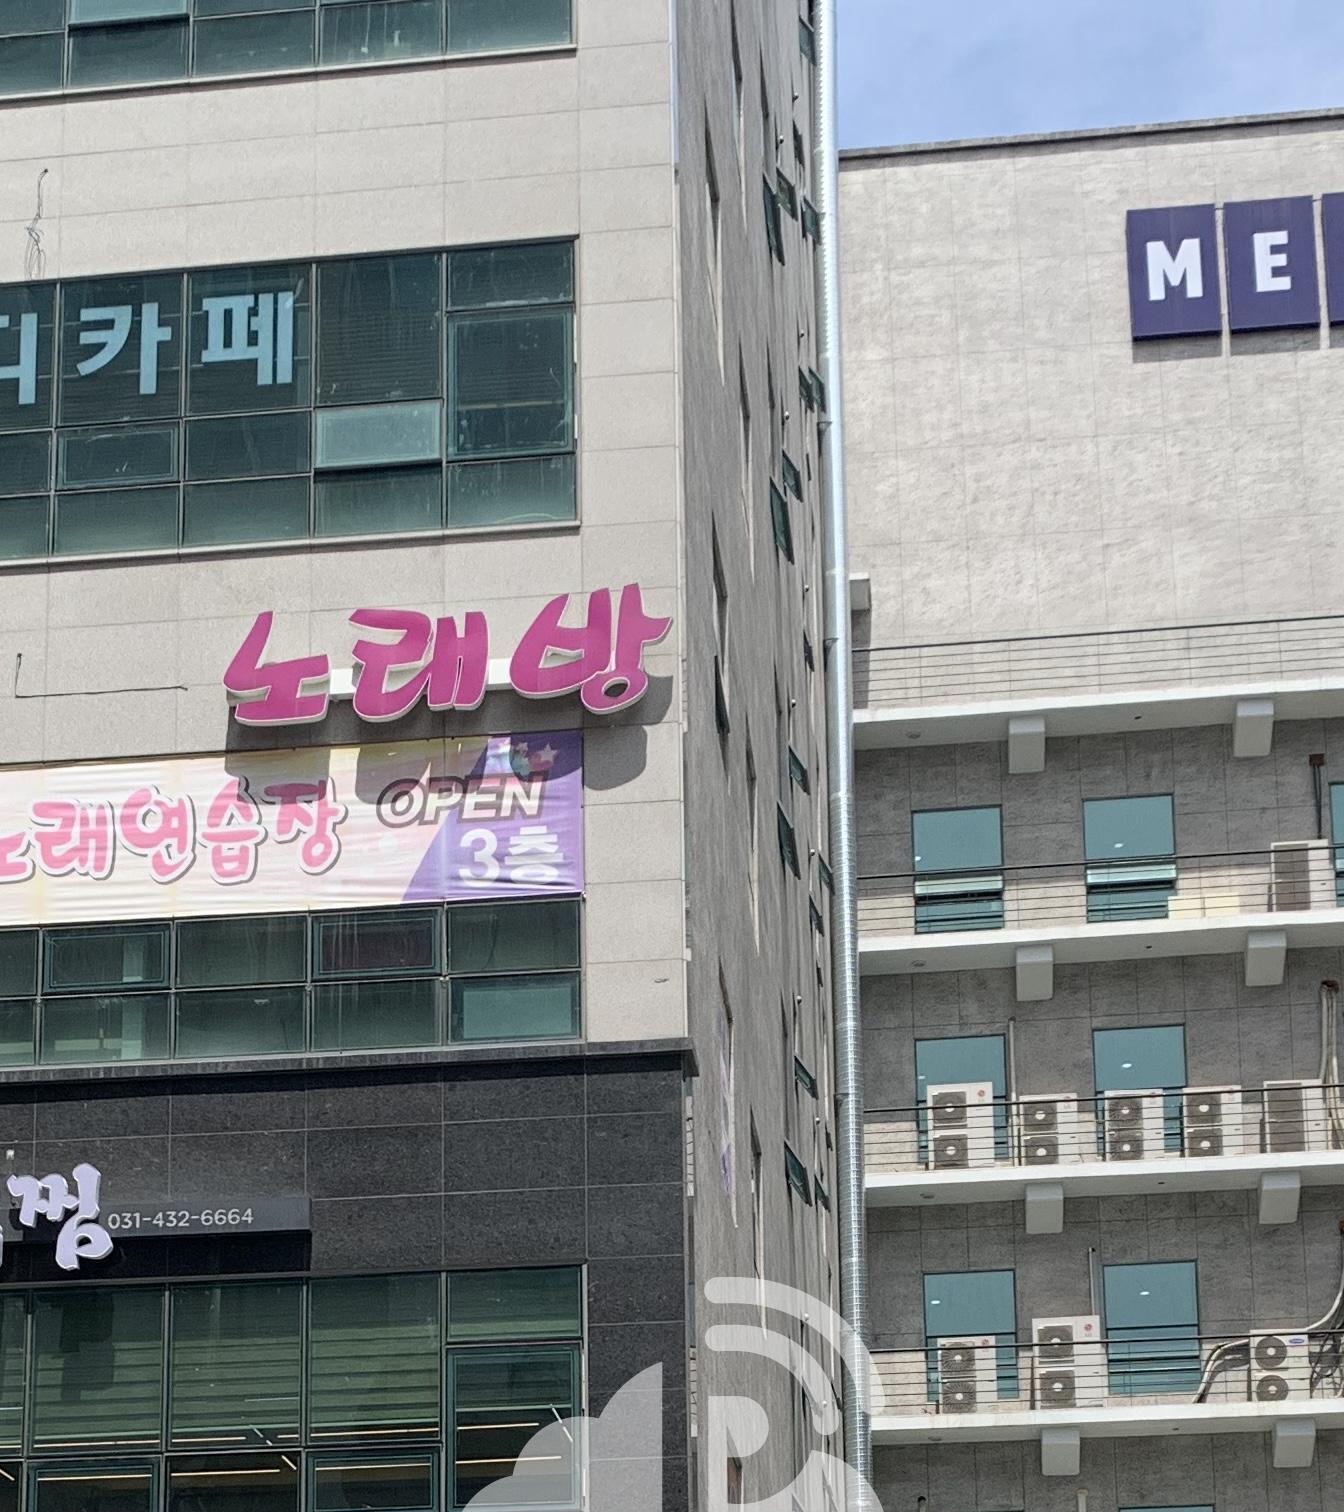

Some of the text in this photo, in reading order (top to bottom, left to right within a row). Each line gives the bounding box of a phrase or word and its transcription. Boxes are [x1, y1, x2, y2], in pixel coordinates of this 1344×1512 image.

[221, 582, 674, 727] 노래방
[376, 774, 548, 828] OPEN
[457, 821, 567, 890] 3층
[106, 1208, 254, 1231] 031-432-6664
